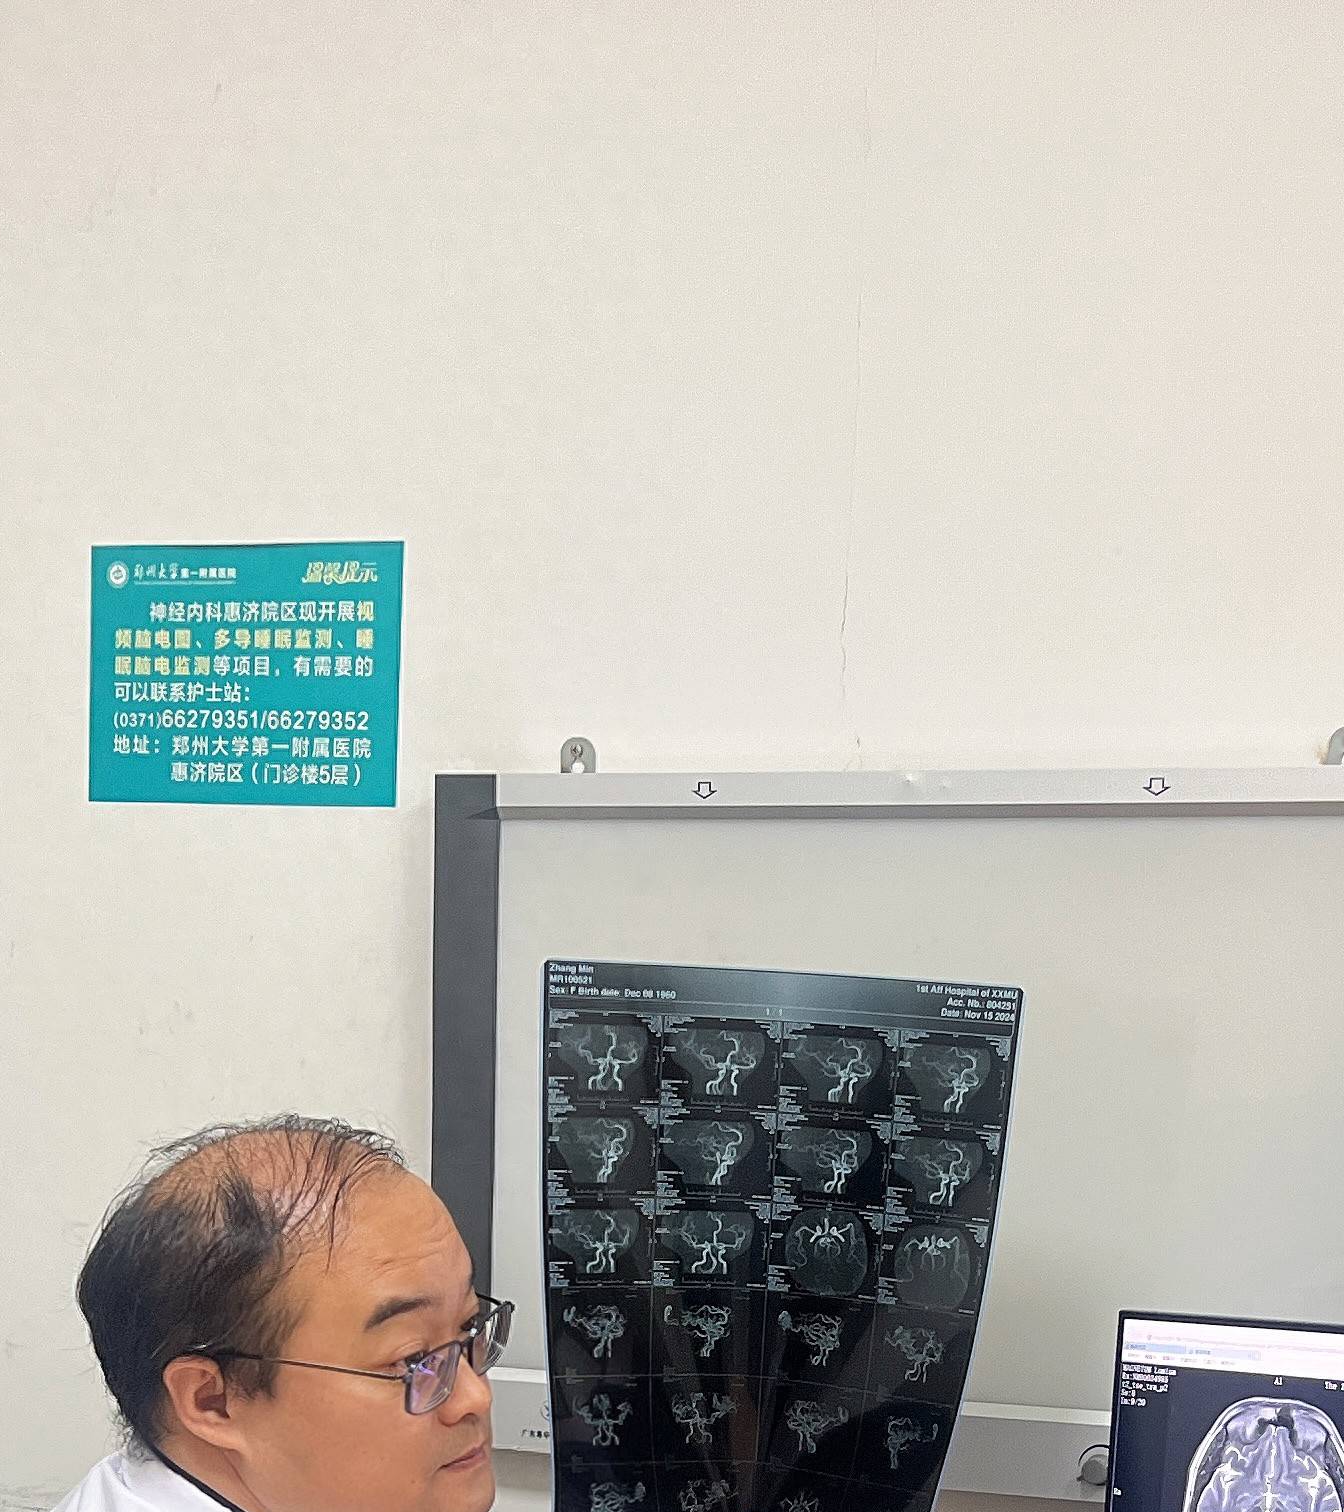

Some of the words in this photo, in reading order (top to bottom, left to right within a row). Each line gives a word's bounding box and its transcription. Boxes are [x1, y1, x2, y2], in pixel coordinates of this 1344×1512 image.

[150, 600, 375, 622] 神经内科惠济院区现开展视
[944, 986, 979, 997] Hospital
[981, 988, 990, 998] of
